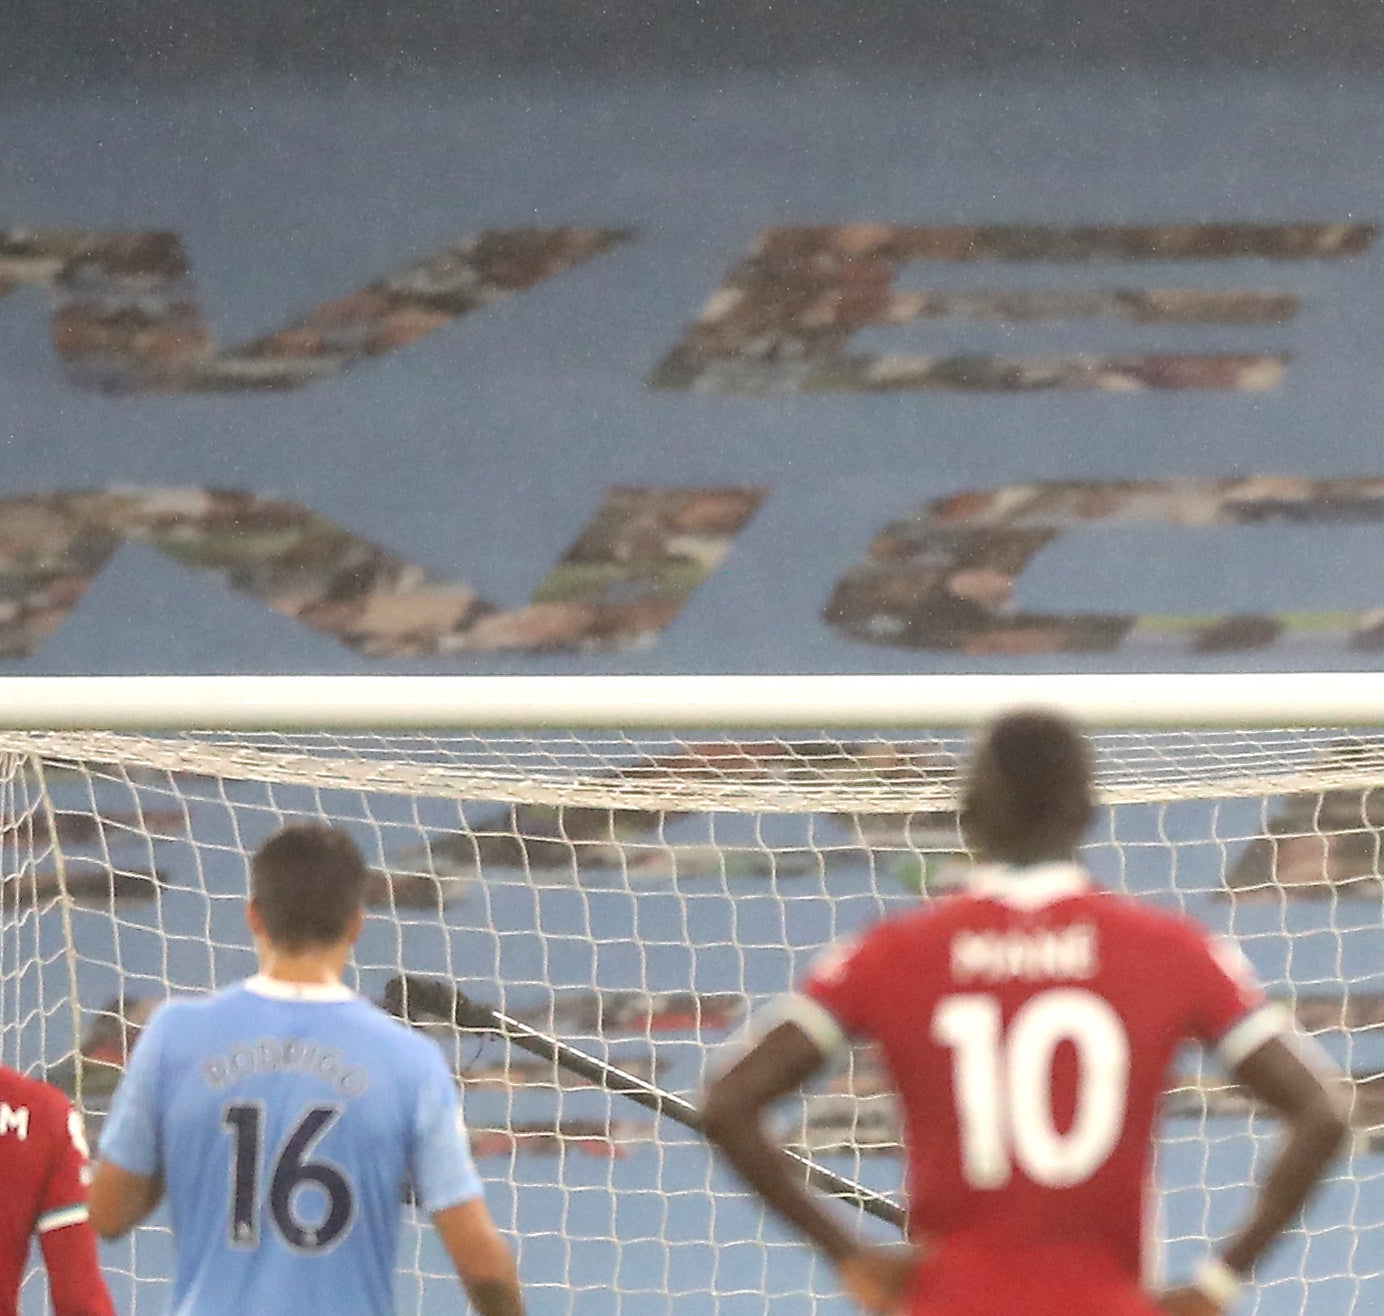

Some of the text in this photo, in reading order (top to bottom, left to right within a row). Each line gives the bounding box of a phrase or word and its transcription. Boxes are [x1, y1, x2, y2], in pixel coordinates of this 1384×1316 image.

[204, 1037, 368, 1097] RODRIGO
[931, 988, 1131, 1190] 10
[223, 1102, 354, 1253] 16
